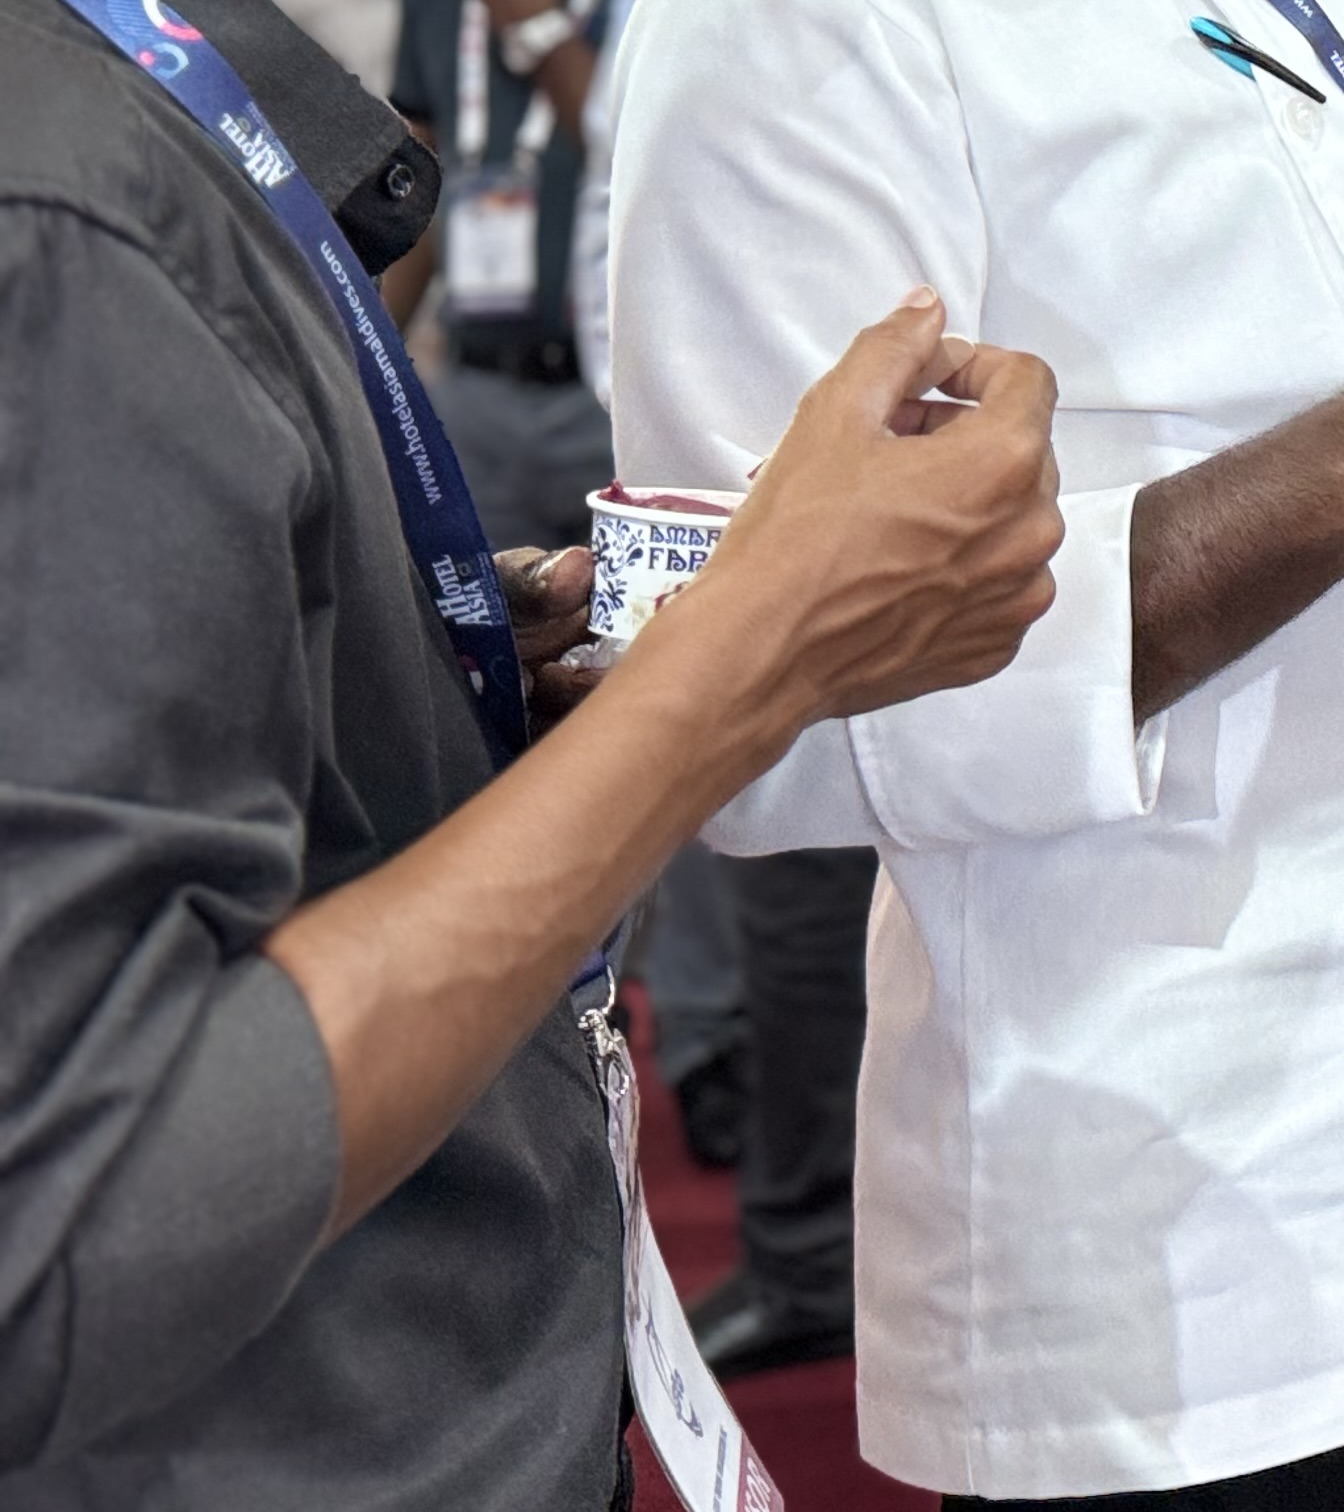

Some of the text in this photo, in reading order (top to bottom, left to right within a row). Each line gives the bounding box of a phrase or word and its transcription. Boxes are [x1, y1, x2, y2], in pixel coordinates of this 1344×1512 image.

[319, 239, 442, 506] www.hotelasiamaldives.com
[649, 523, 722, 548] AMAR
[432, 553, 470, 618] HOTEL
[450, 578, 492, 626] ASIA
